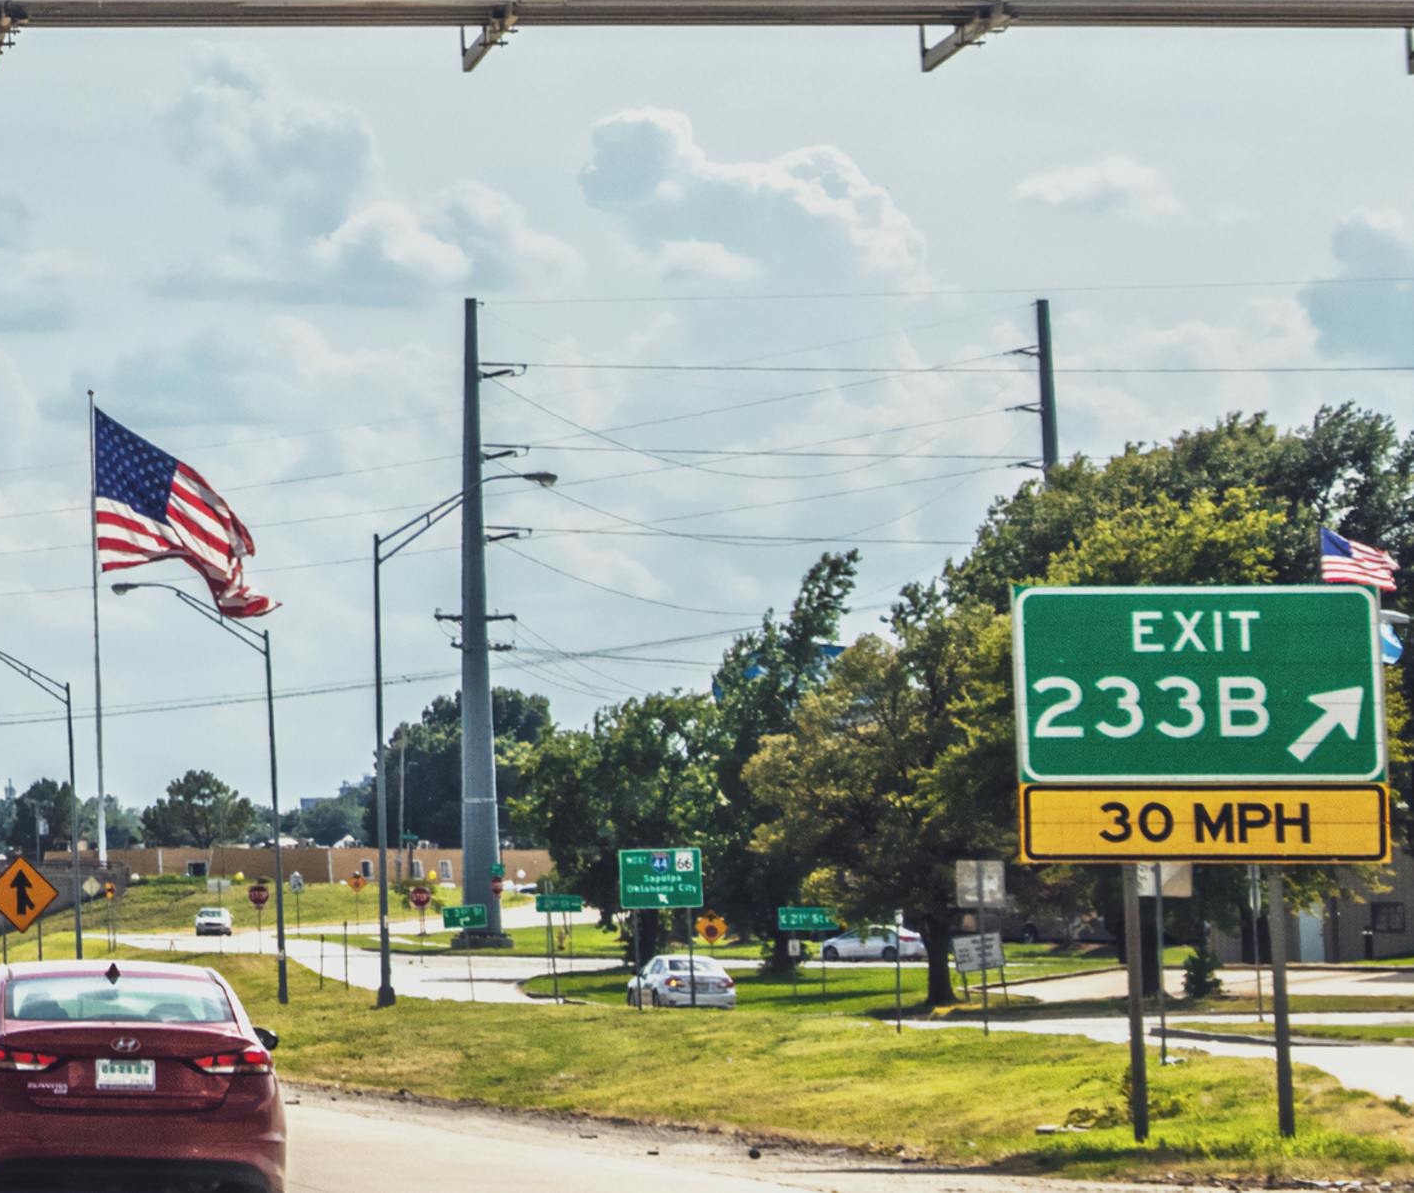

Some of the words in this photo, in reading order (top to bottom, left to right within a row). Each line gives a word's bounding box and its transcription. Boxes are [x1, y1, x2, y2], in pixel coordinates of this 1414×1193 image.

[1132, 610, 1260, 652] EXIT
[1033, 676, 1269, 738] 233B
[1099, 802, 1174, 843] 30
[1193, 802, 1311, 844] MPH
[653, 858, 668, 867] 44
[676, 857, 692, 869] 66
[625, 884, 674, 894] Oklahoma
[678, 884, 697, 893] City
[643, 874, 682, 883] Sapulpa
